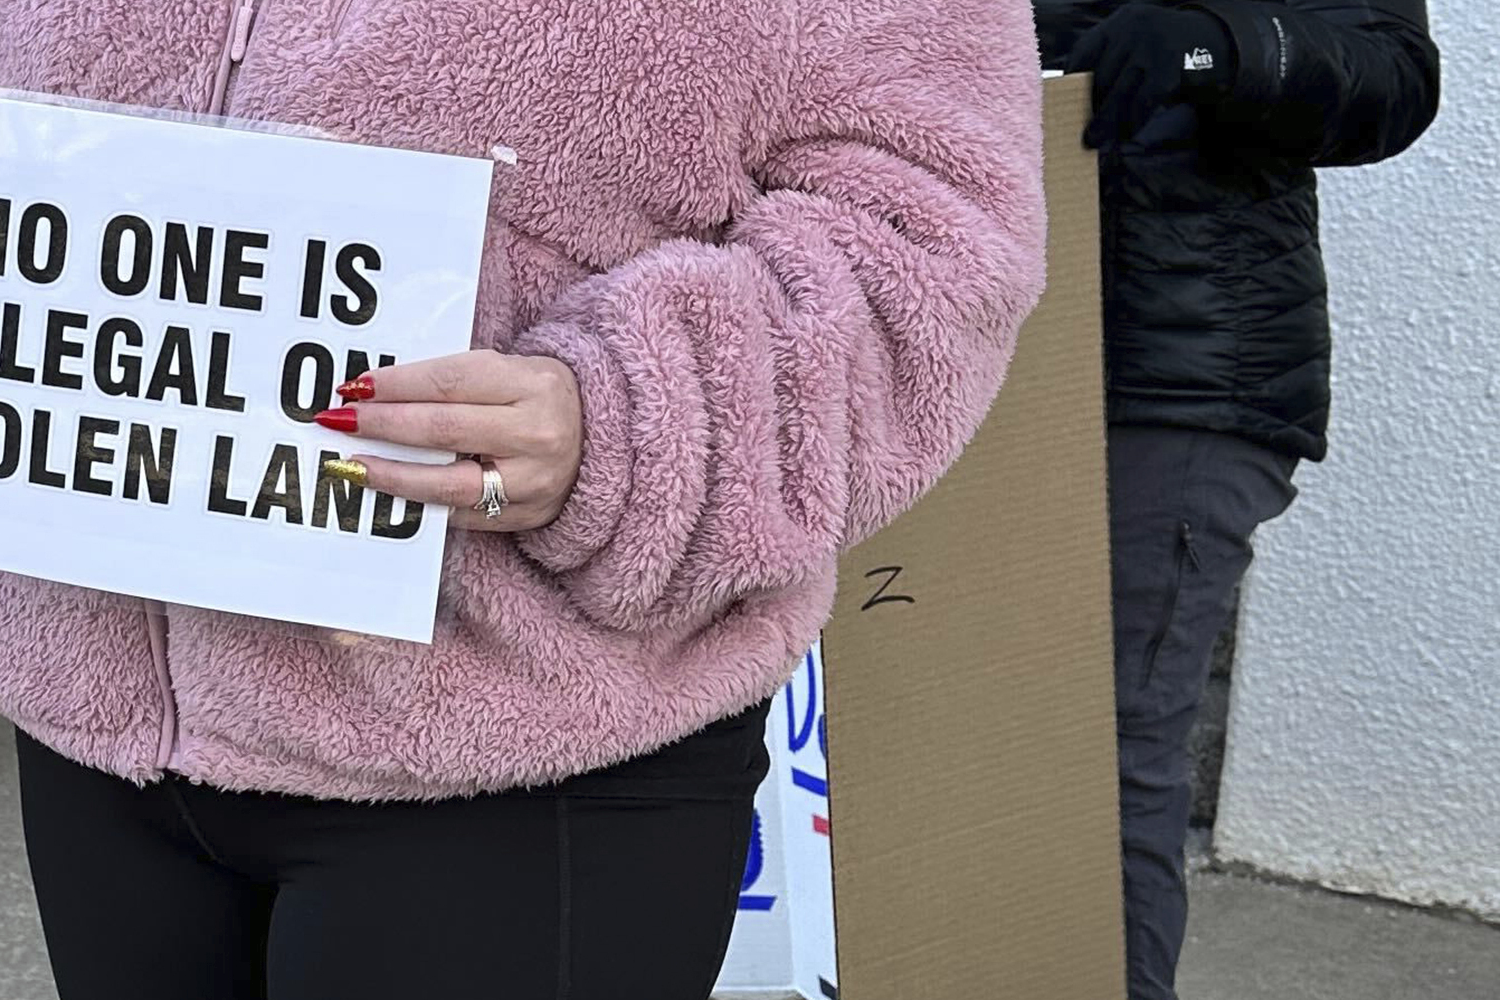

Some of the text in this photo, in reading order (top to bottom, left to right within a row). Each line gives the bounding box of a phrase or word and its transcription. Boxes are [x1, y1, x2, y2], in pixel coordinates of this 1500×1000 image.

[101, 214, 269, 312] ONE
[300, 239, 382, 326] IS
[207, 435, 425, 540] LAND
